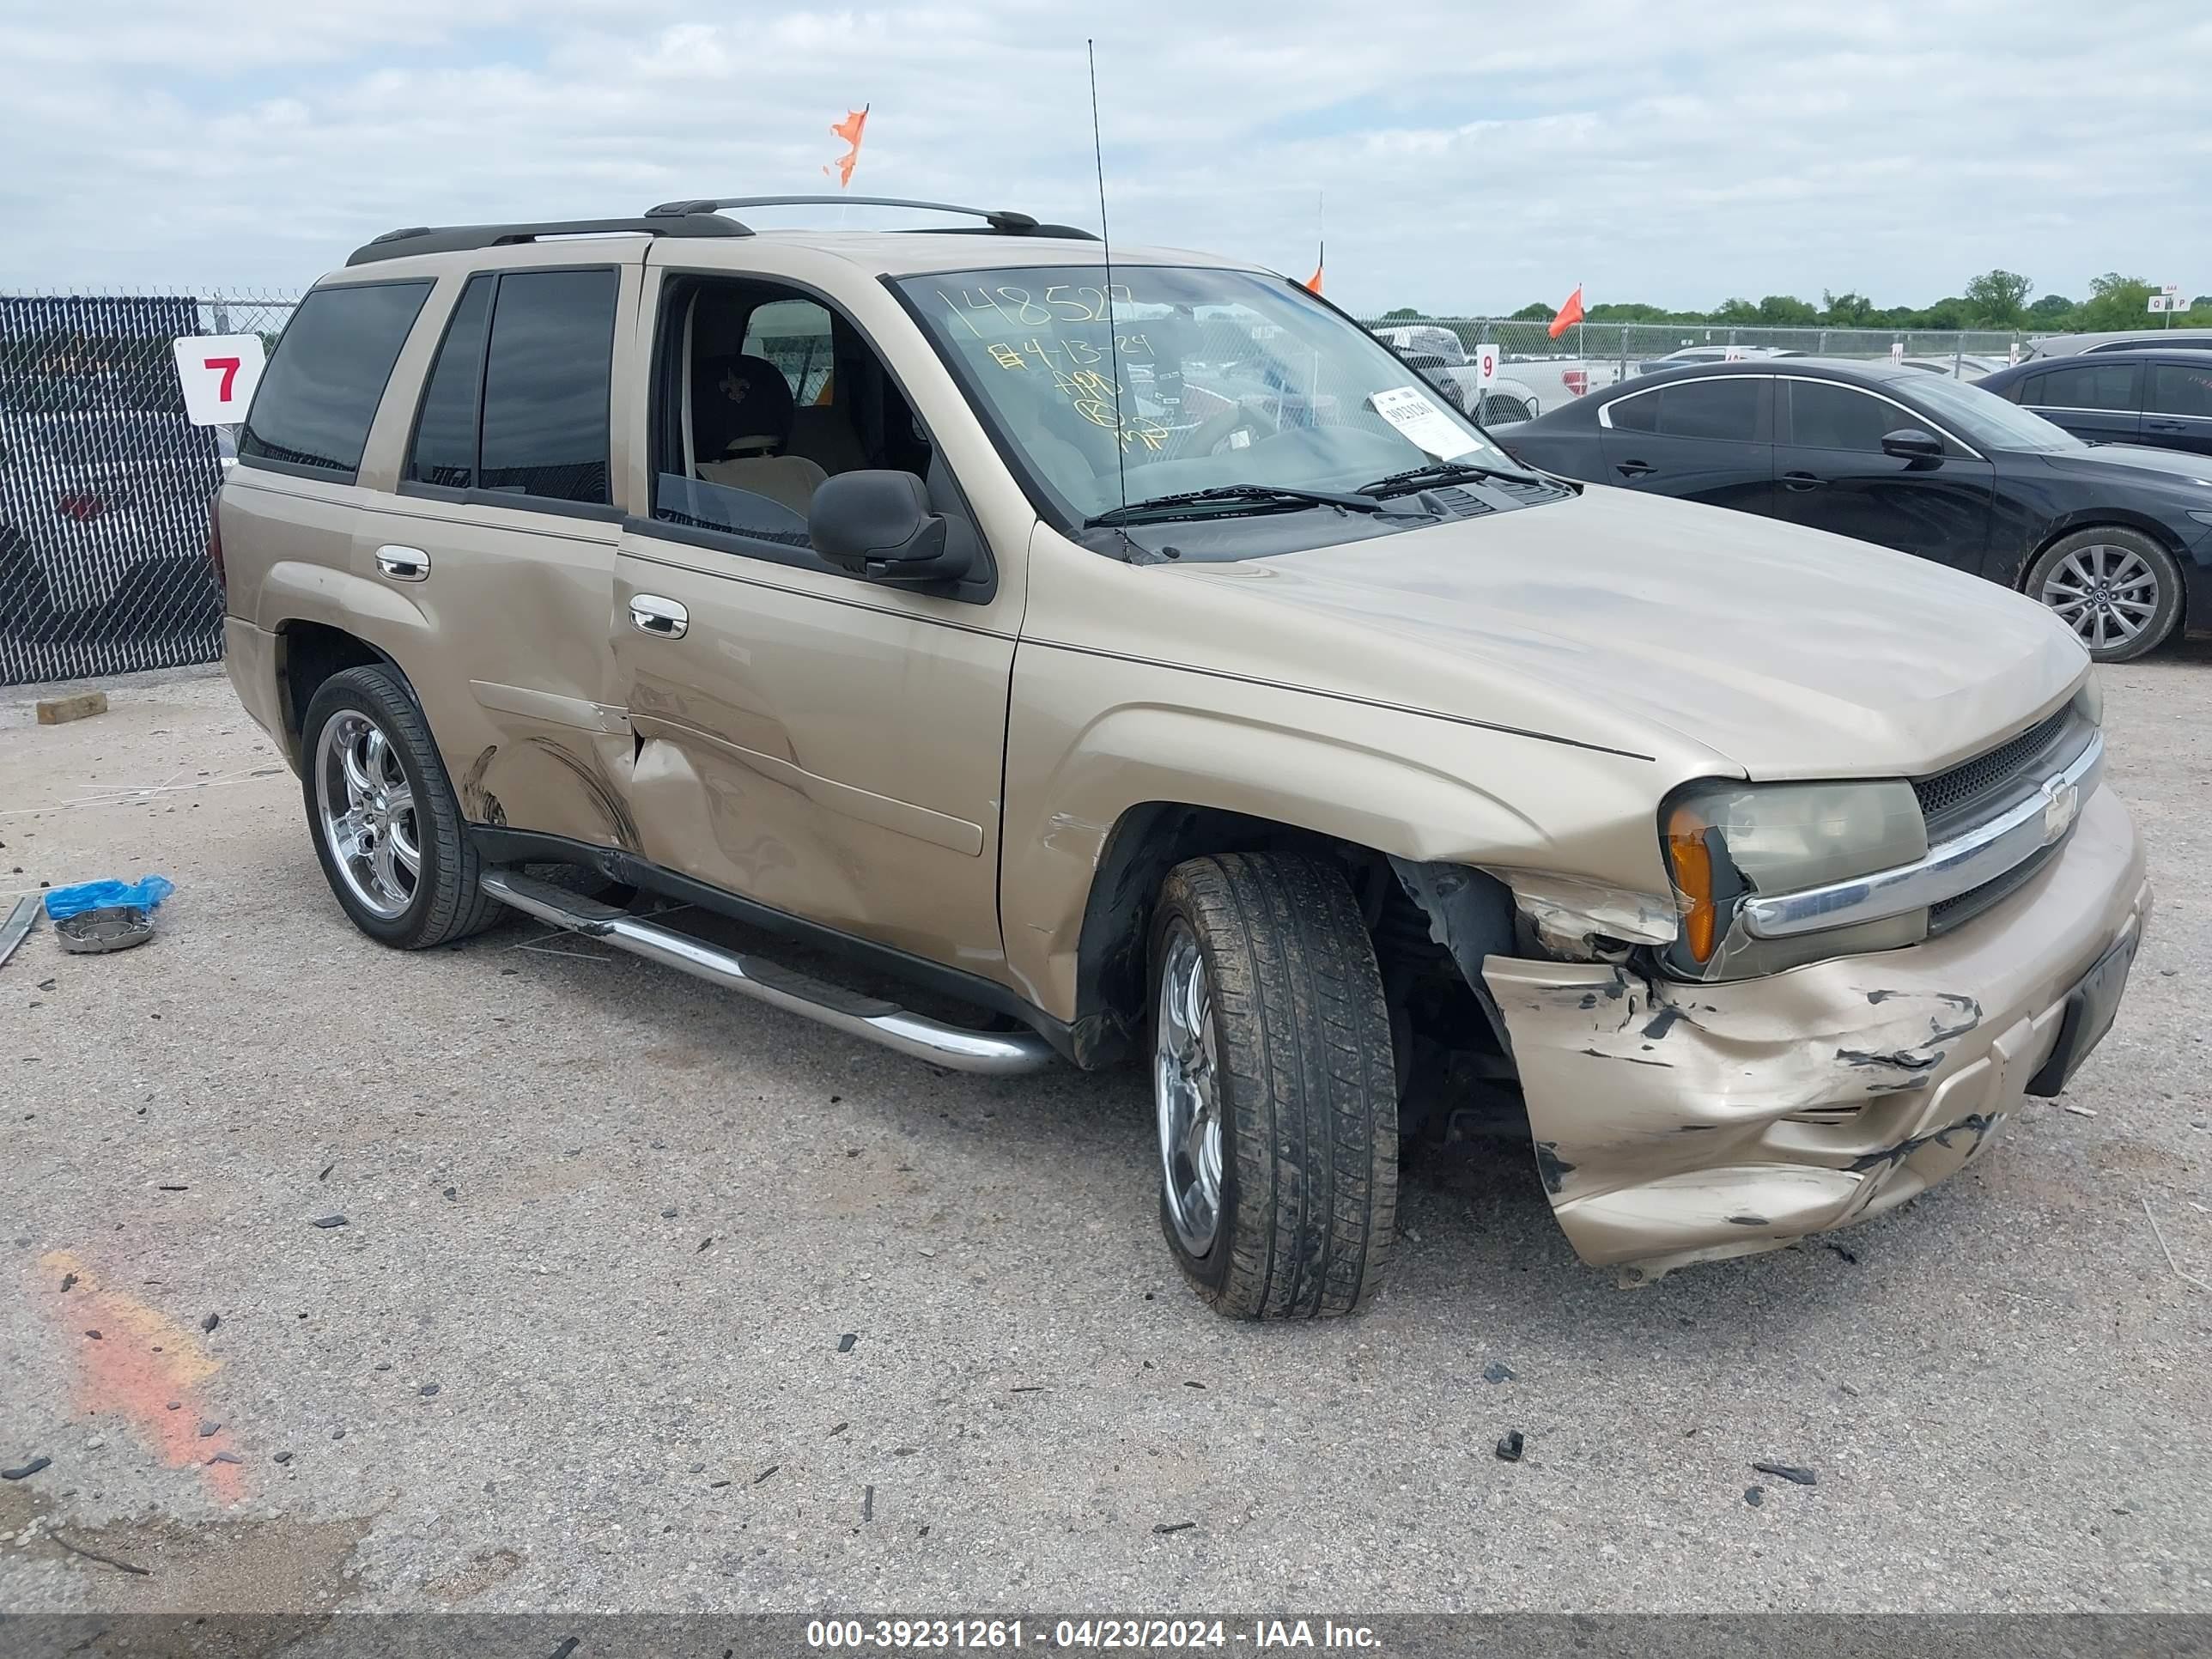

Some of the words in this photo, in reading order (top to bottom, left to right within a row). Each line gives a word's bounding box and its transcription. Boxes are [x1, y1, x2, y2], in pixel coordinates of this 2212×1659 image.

[2179, 299, 2185, 307] P
[1484, 356, 1492, 376] 9
[204, 357, 240, 402] 7
[1385, 401, 1434, 422] 39231261
